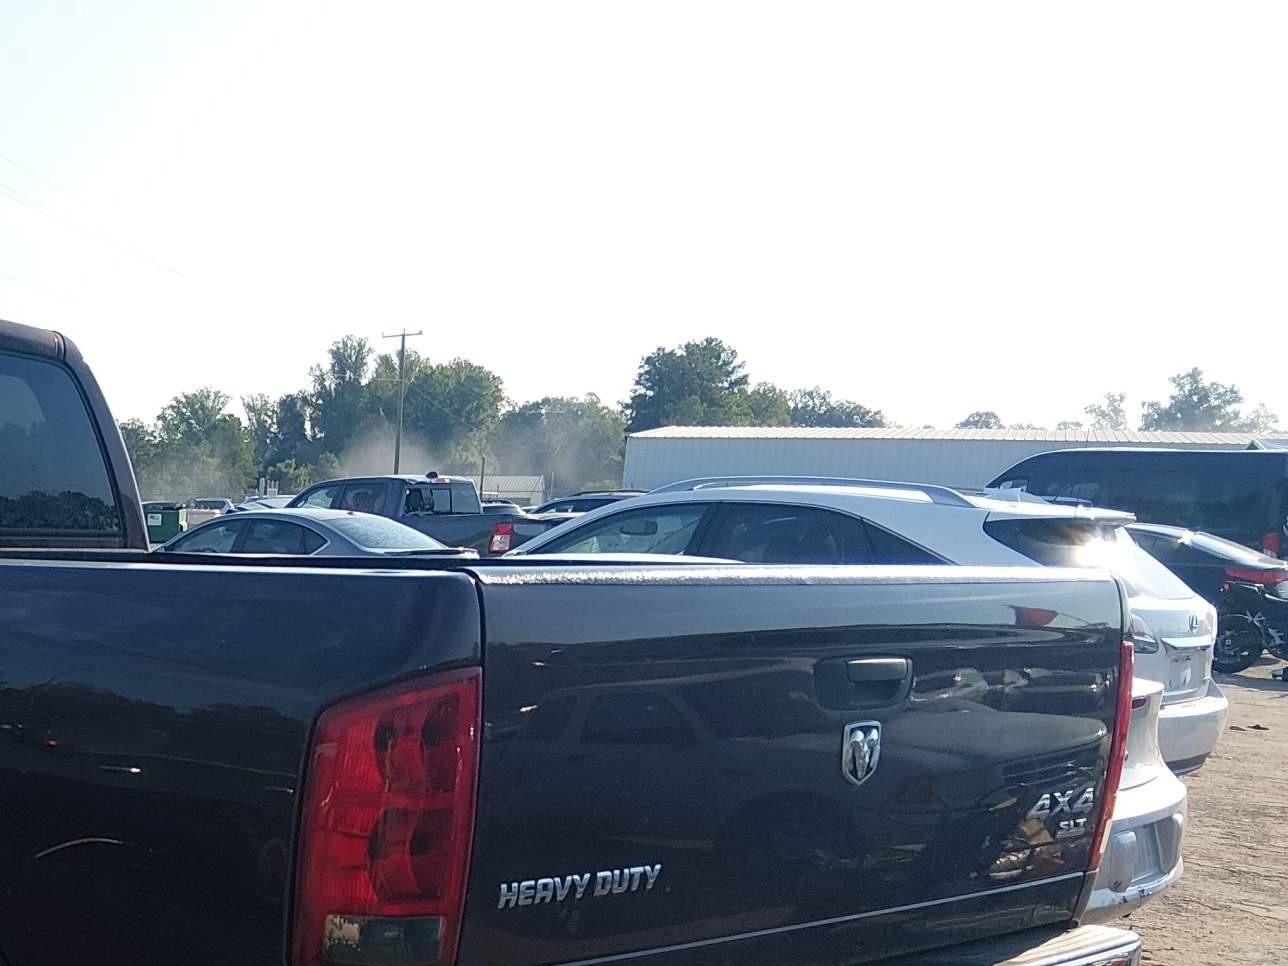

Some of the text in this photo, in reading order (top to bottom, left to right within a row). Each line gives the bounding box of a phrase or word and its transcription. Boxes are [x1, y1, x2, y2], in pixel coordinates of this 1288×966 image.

[1058, 817, 1088, 832] SLT
[497, 863, 662, 909] HEAVY DUTY
